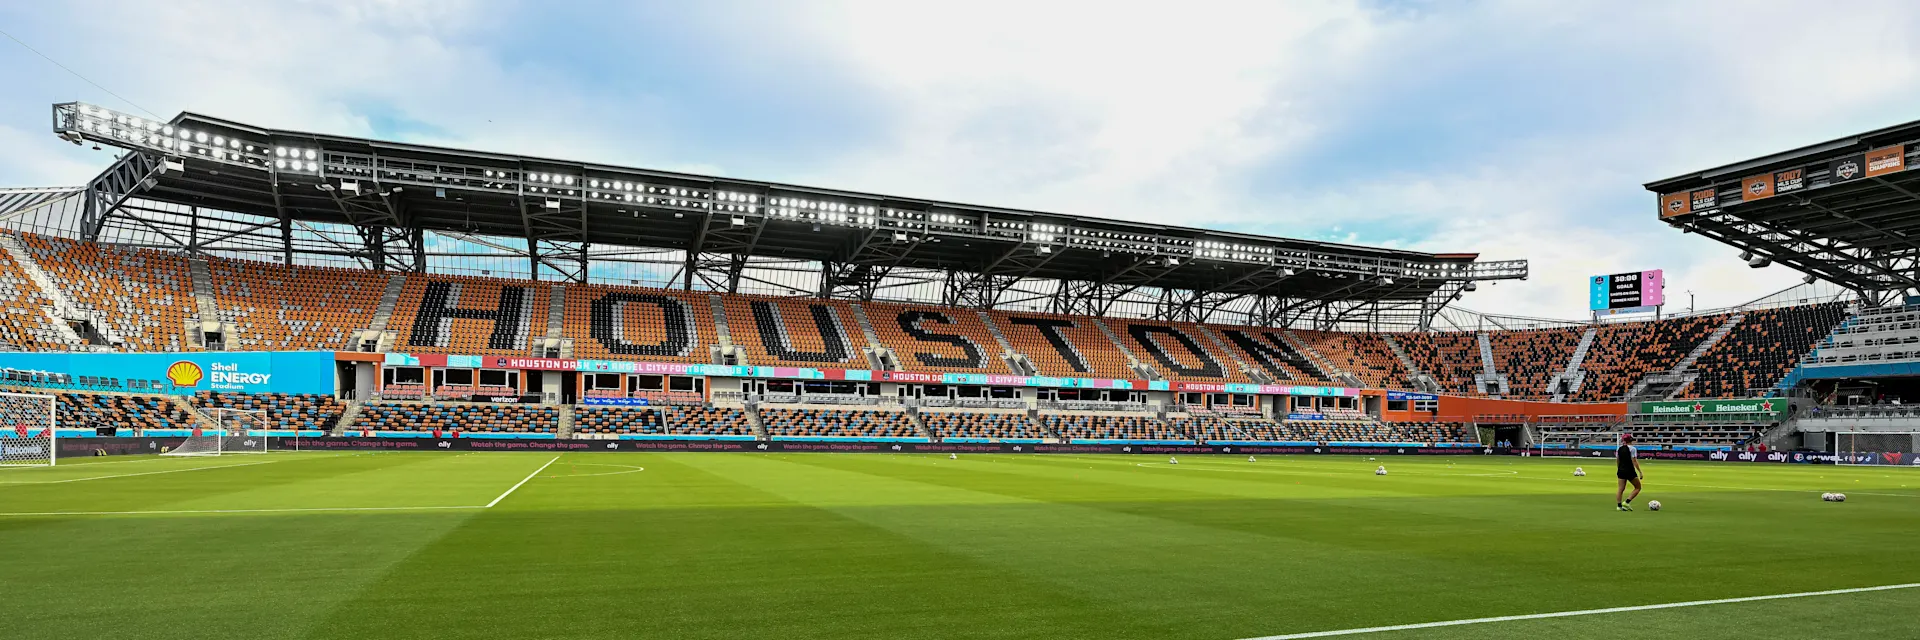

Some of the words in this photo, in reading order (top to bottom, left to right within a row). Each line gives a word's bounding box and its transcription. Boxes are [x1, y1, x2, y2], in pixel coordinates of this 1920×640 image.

[1869, 161, 1900, 172] CHAMPIONS
[1777, 169, 1801, 182] 2007
[1777, 183, 1803, 192] CHAMPIONS
[1693, 189, 1715, 200] 2006
[408, 279, 1338, 383] HOUSTON
[211, 362, 238, 371] Shell
[511, 359, 560, 369] HOUSTON
[562, 360, 590, 369] DASH
[611, 362, 643, 371] ANGEL
[646, 363, 667, 371] CITY
[211, 371, 271, 384] ENERGY
[893, 373, 931, 381] HOUSTON
[1653, 405, 1690, 413] Heineken
[1716, 403, 1758, 411] Heineken
[1710, 451, 1728, 461] ally
[1738, 451, 1757, 462] ally
[1767, 452, 1787, 462] ally
